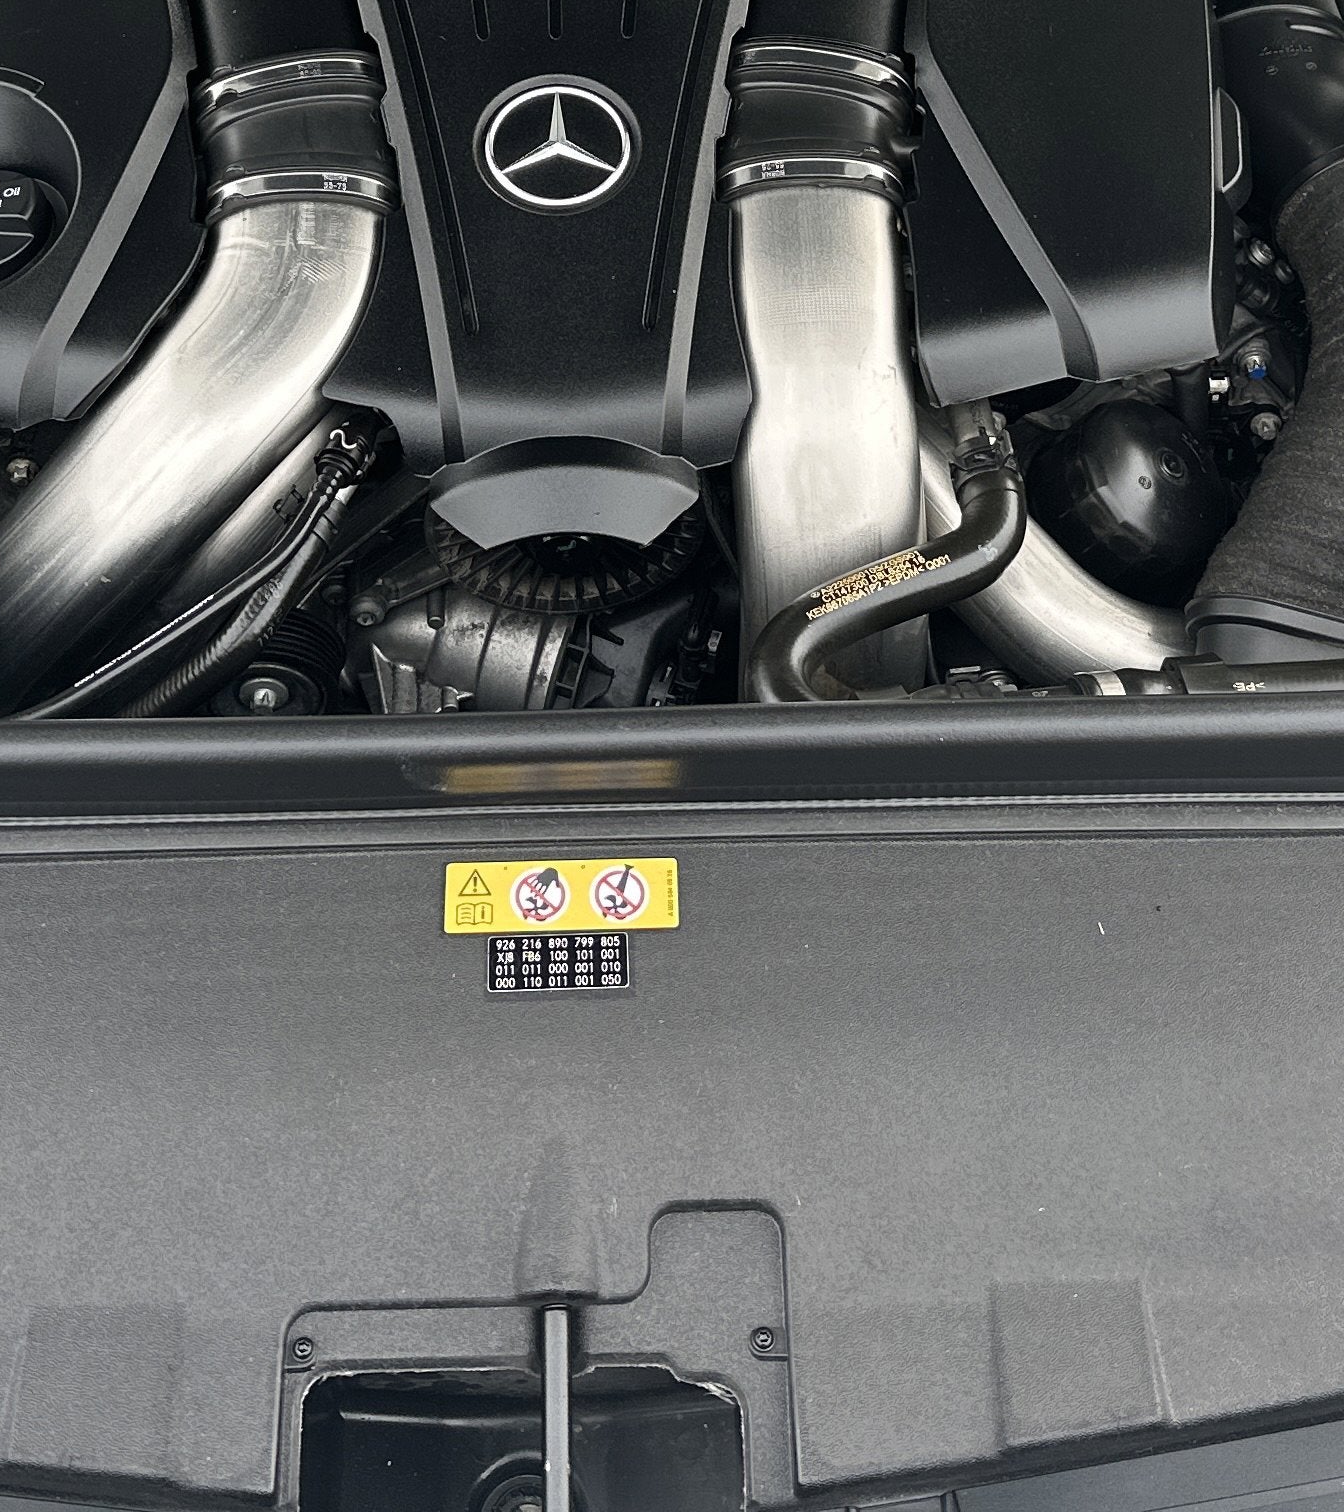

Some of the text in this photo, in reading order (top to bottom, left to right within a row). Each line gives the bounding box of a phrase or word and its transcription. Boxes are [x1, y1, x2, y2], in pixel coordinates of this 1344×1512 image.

[3, 187, 21, 198] Oil
[496, 936, 620, 951] 926 216 890 799 805
[550, 950, 568, 961] 100
[576, 949, 594, 961] 101
[600, 948, 620, 960] 001
[496, 961, 621, 976] 011 011 000 001 010
[495, 974, 622, 989] 000 110 011 001 050
